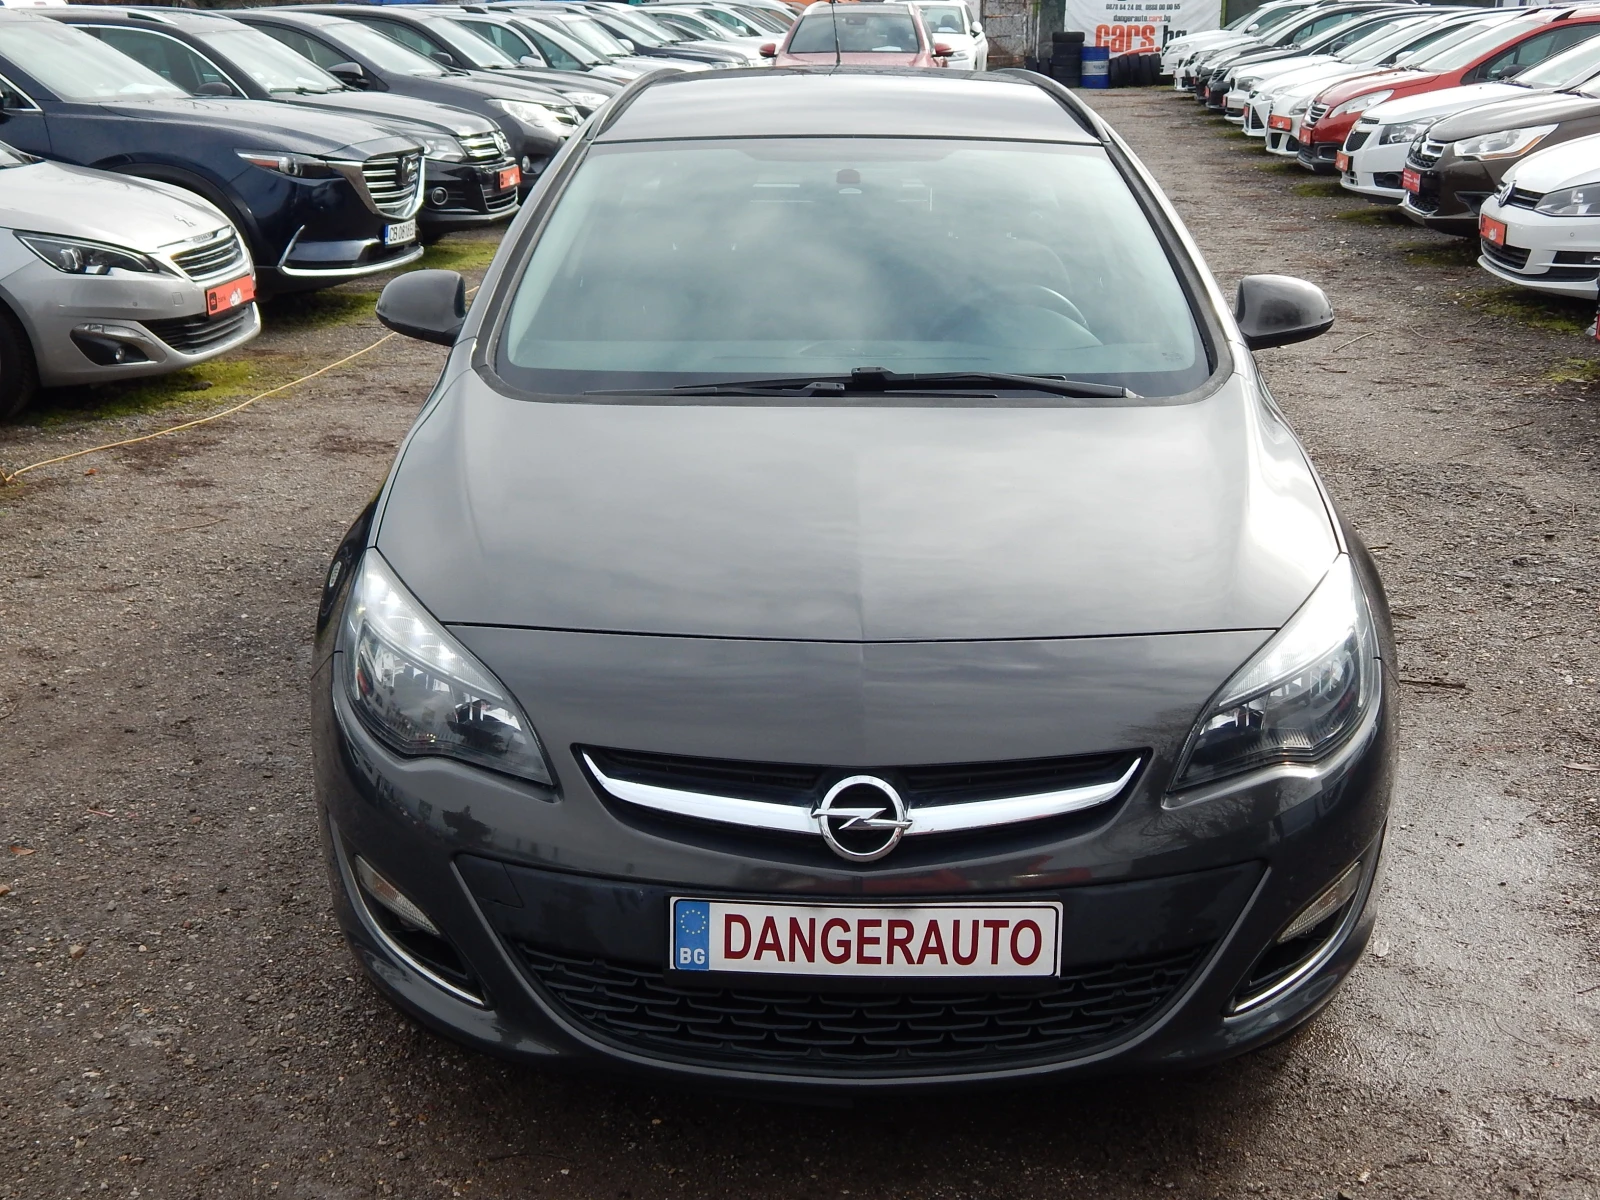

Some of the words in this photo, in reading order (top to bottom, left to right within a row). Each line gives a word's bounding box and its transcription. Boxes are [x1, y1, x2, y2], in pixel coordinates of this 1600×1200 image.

[838, 777, 888, 790] OPEL
[680, 948, 705, 965] BG
[724, 913, 1043, 966] DANGERAUTO
